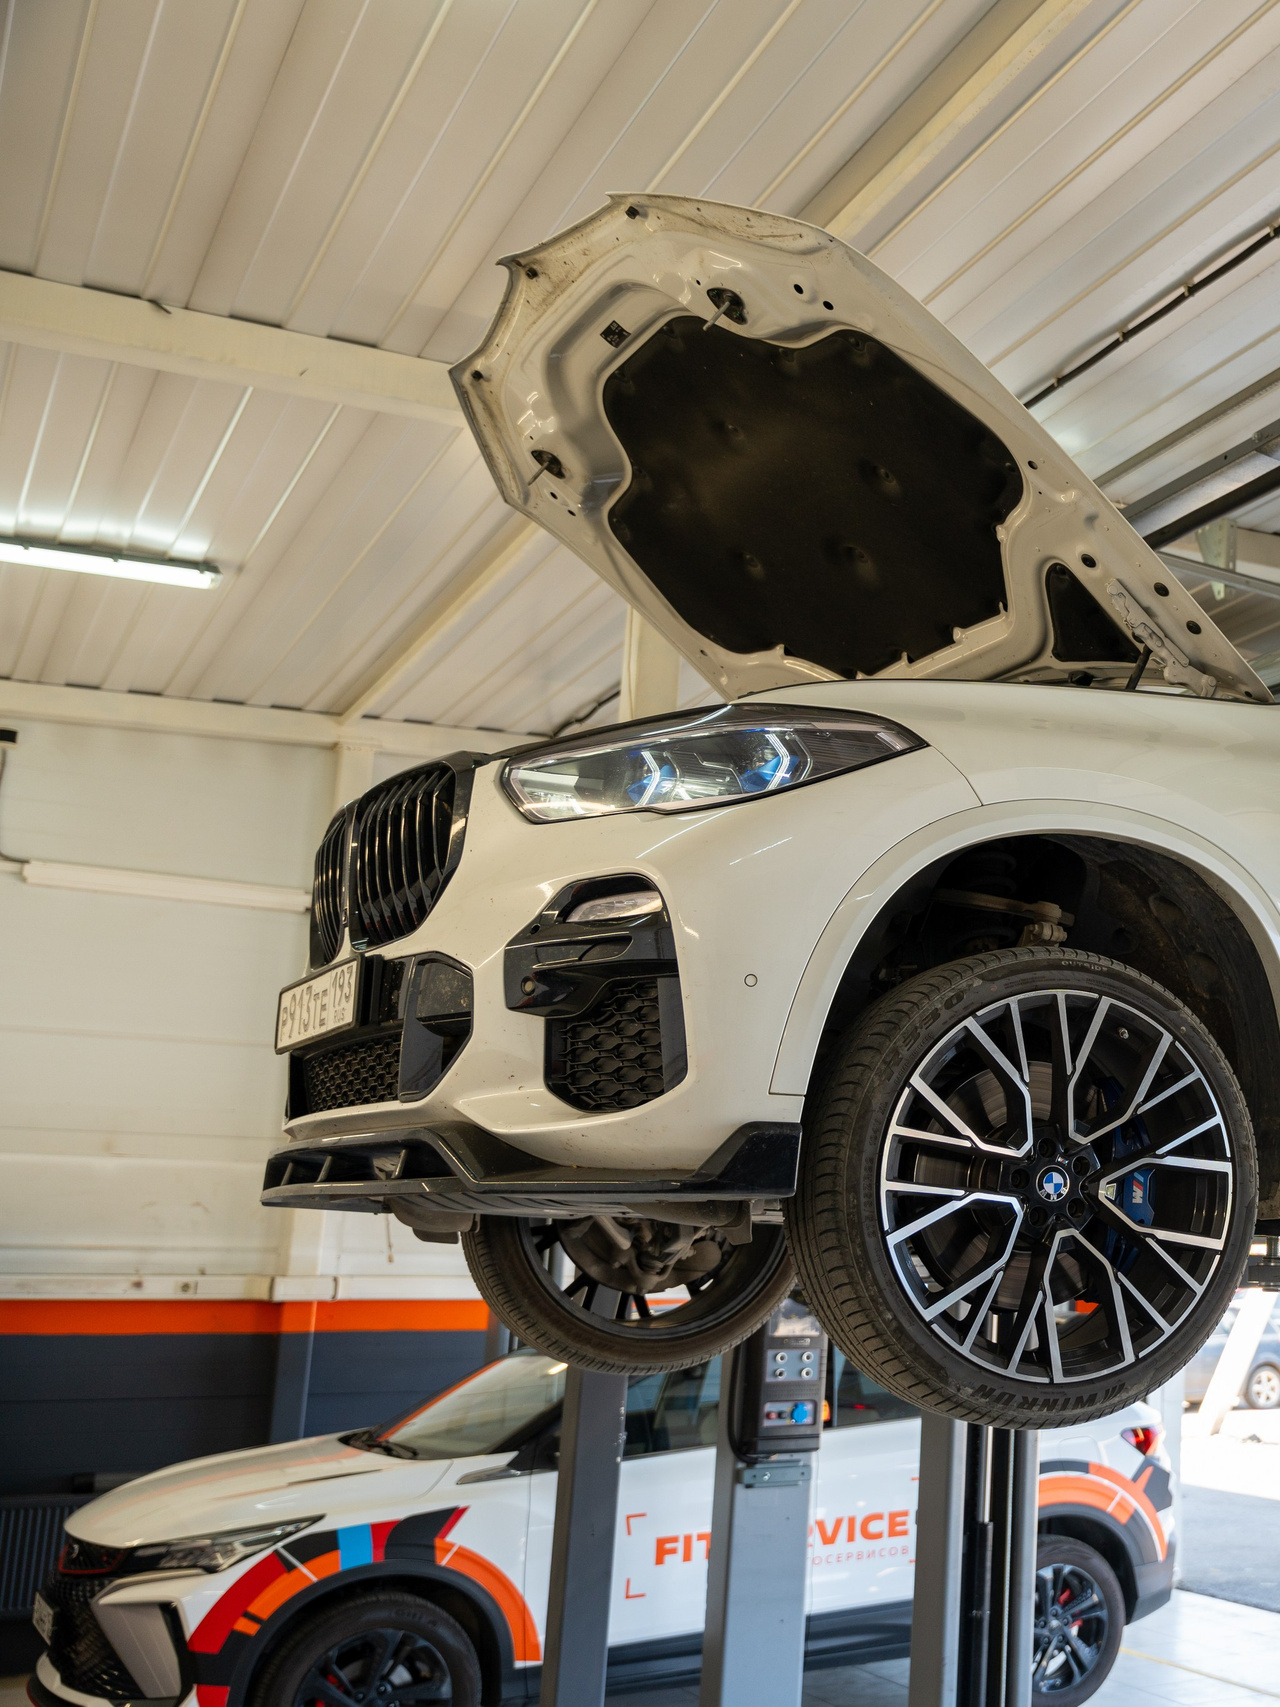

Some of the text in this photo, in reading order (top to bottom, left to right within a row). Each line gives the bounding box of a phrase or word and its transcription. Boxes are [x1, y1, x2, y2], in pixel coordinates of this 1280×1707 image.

[332, 965, 354, 1009] 193
[333, 1007, 347, 1025] RUS
[969, 1383, 1098, 1412] WINRUN
[807, 1509, 910, 1548] VICE
